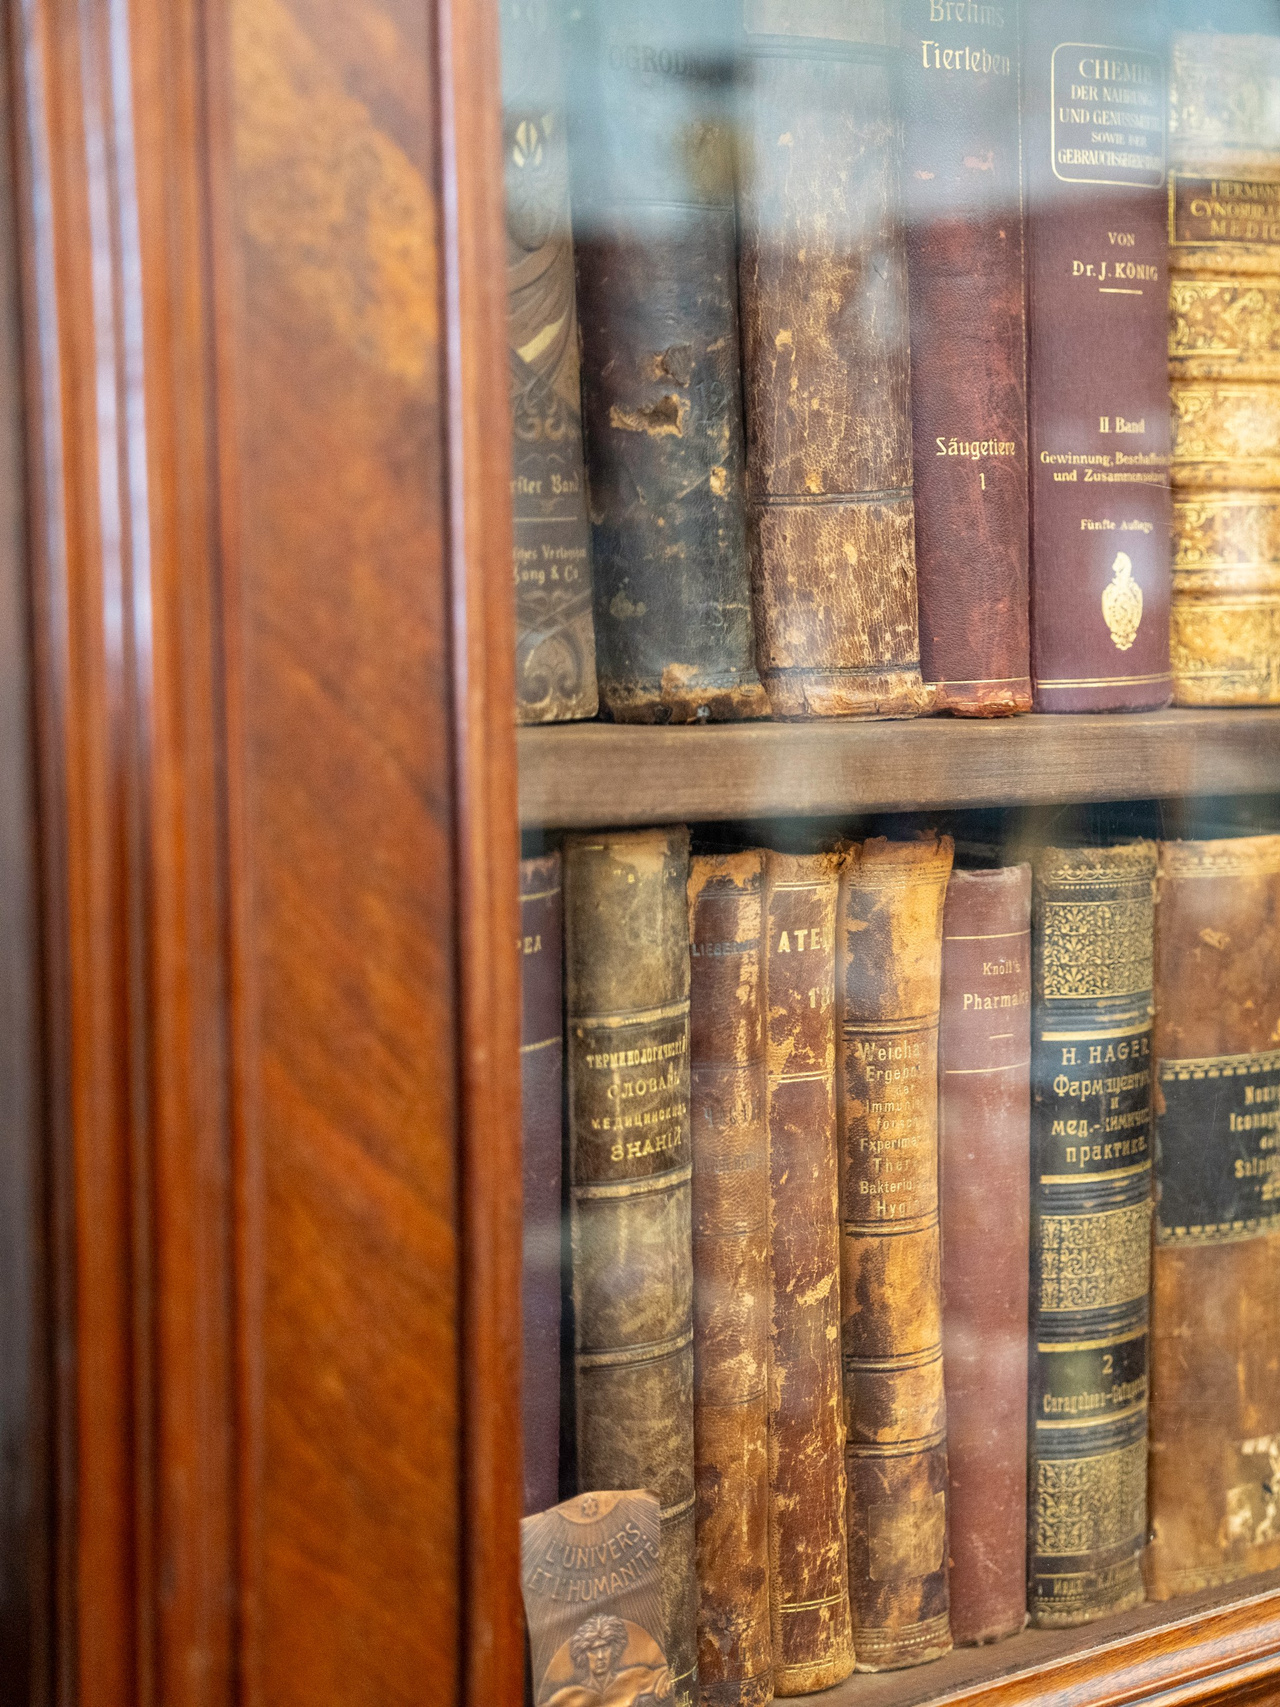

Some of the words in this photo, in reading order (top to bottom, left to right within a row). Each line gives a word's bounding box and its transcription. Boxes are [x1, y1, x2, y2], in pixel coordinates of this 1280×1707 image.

[921, 40, 1010, 76] Tierleben
[1071, 84, 1099, 101] DER
[1058, 107, 1090, 124] UND
[1108, 231, 1135, 247] VON
[1072, 260, 1096, 277] Dr.
[1098, 261, 1112, 281] J.
[1114, 261, 1158, 281] KÖNIG
[1115, 417, 1145, 434] Band
[936, 436, 1016, 460] Säugetiere
[1040, 451, 1114, 467] Gewinnung,
[1053, 469, 1078, 482] und
[1080, 518, 1117, 531] Fünfte
[983, 959, 1021, 976] Knoll's
[1102, 1354, 1114, 1375] 2
